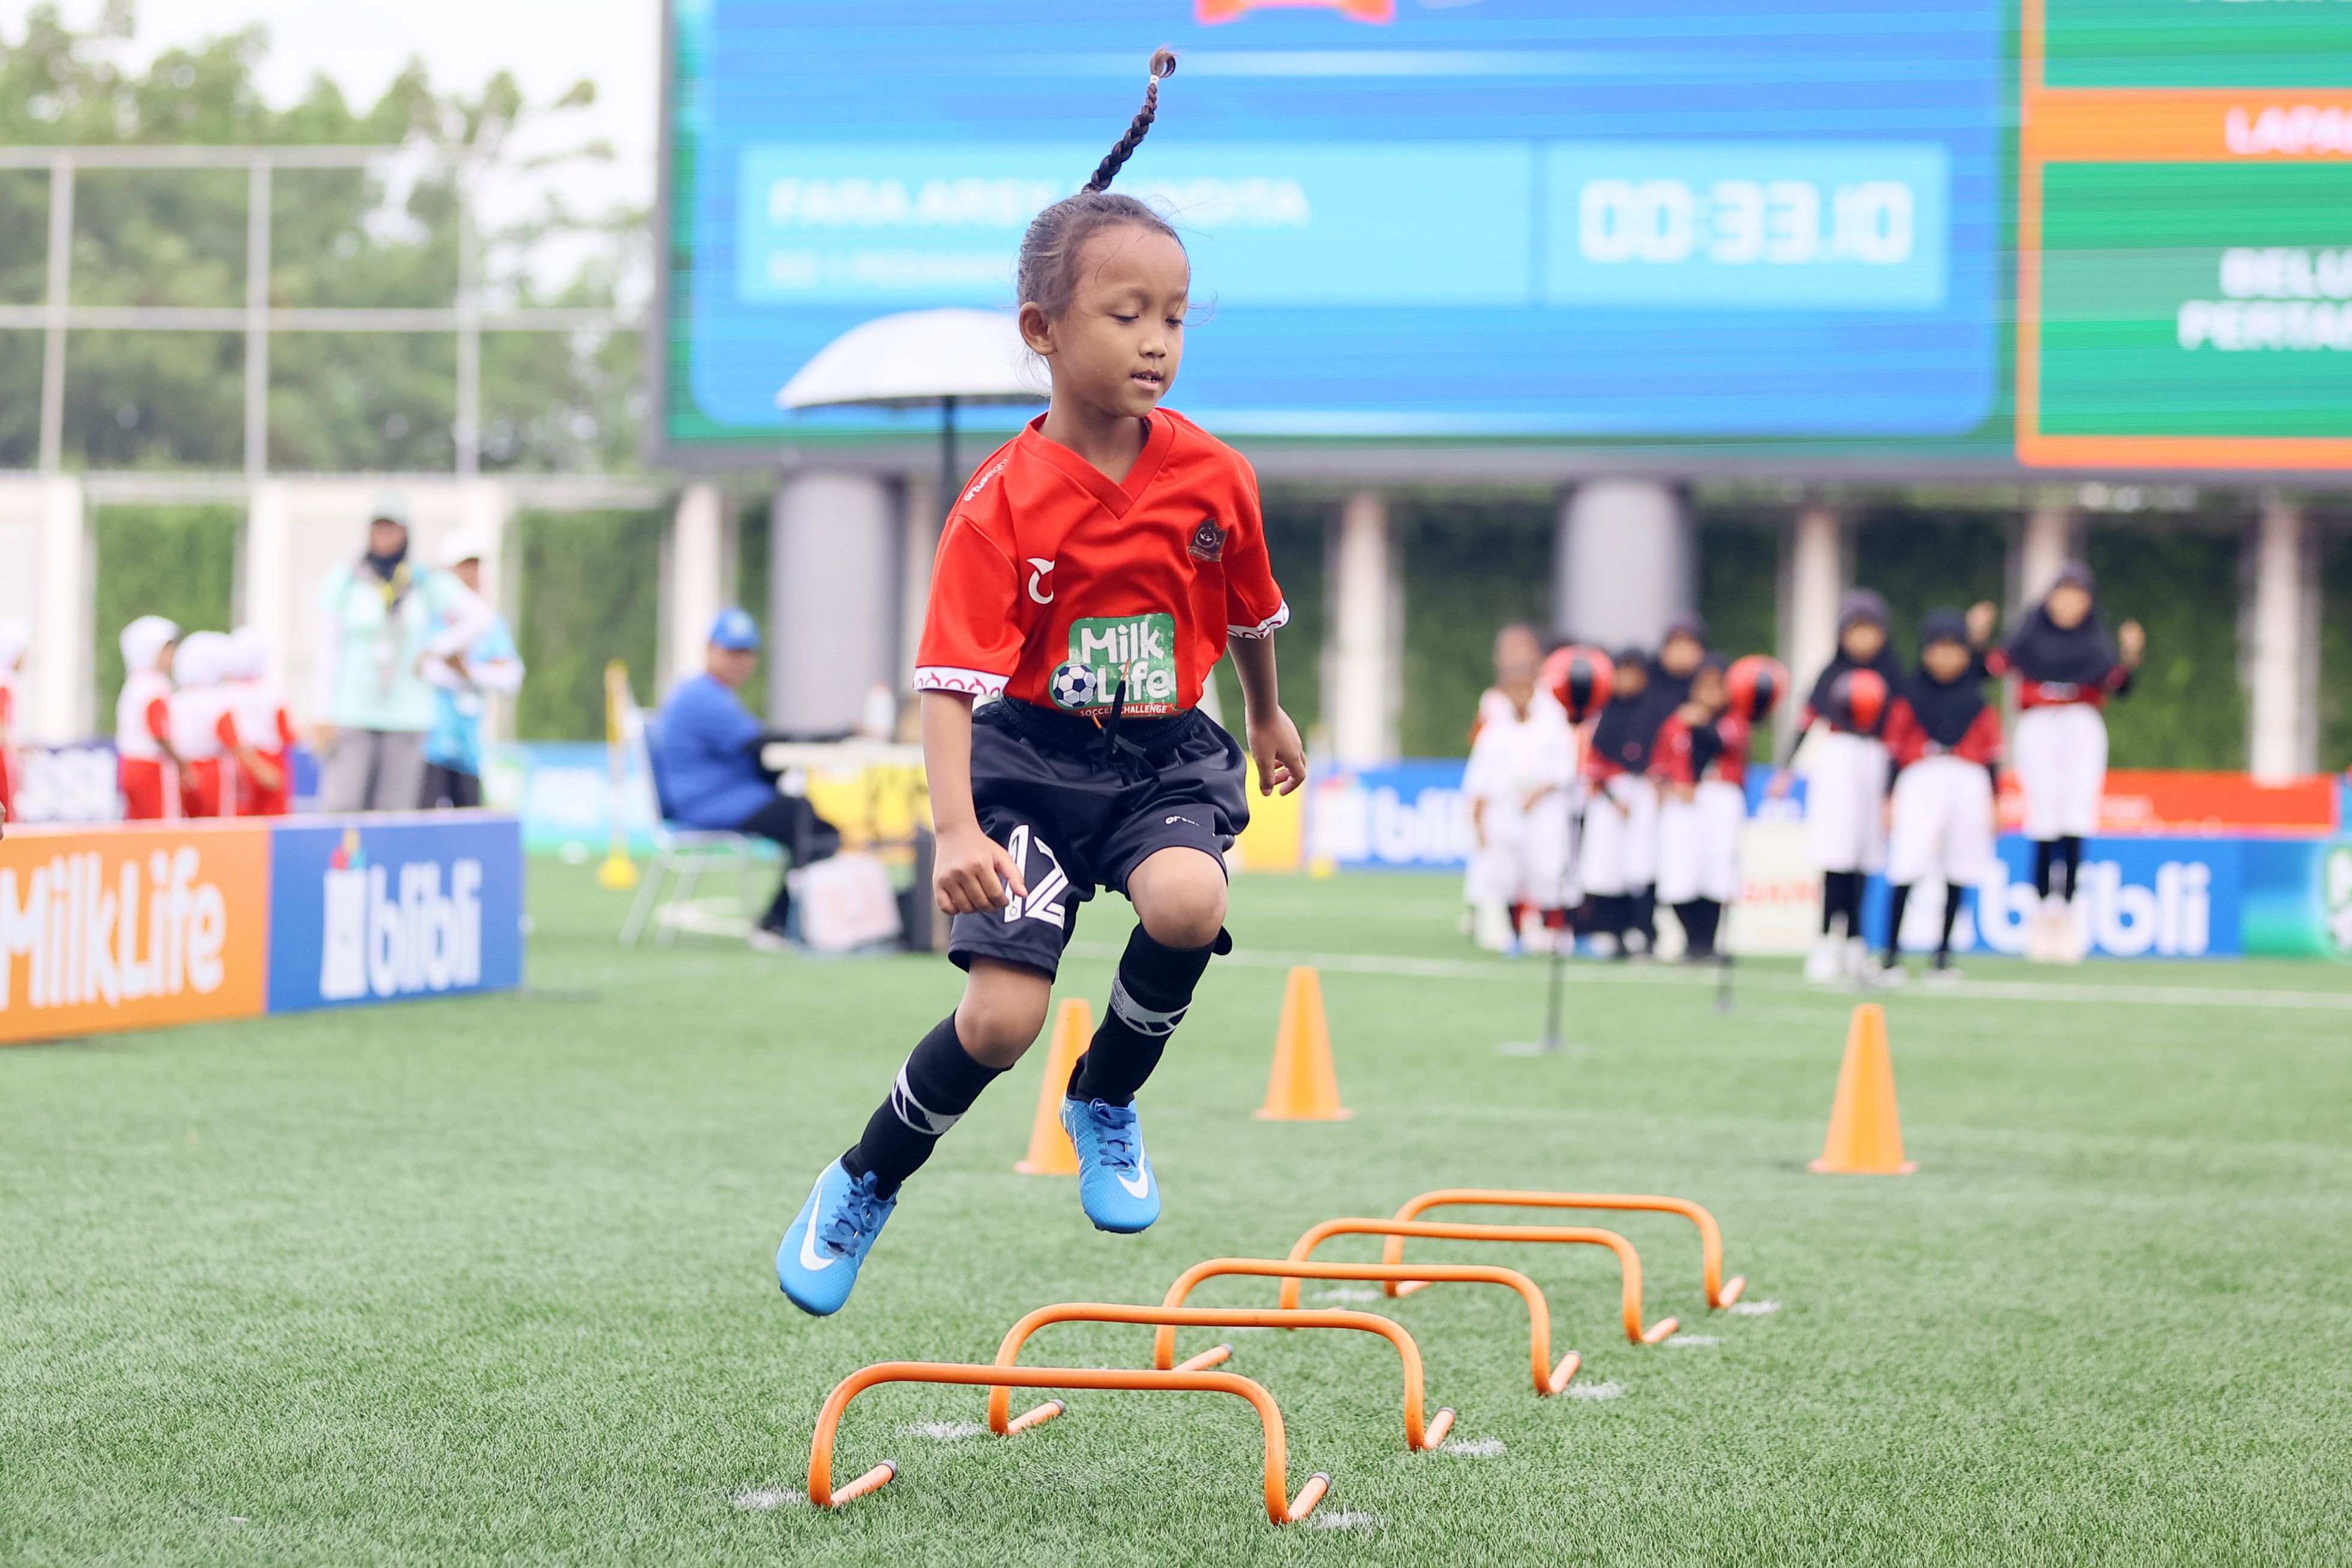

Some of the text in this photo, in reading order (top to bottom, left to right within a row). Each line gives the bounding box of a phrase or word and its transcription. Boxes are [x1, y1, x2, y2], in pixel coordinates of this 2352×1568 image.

[2225, 104, 2352, 155] LAPA
[1581, 179, 1914, 264] 00:33.10
[1081, 621, 1164, 664] Milk
[1097, 661, 1171, 703] Life
[1004, 825, 1069, 930] 12
[369, 857, 481, 998] blibli
